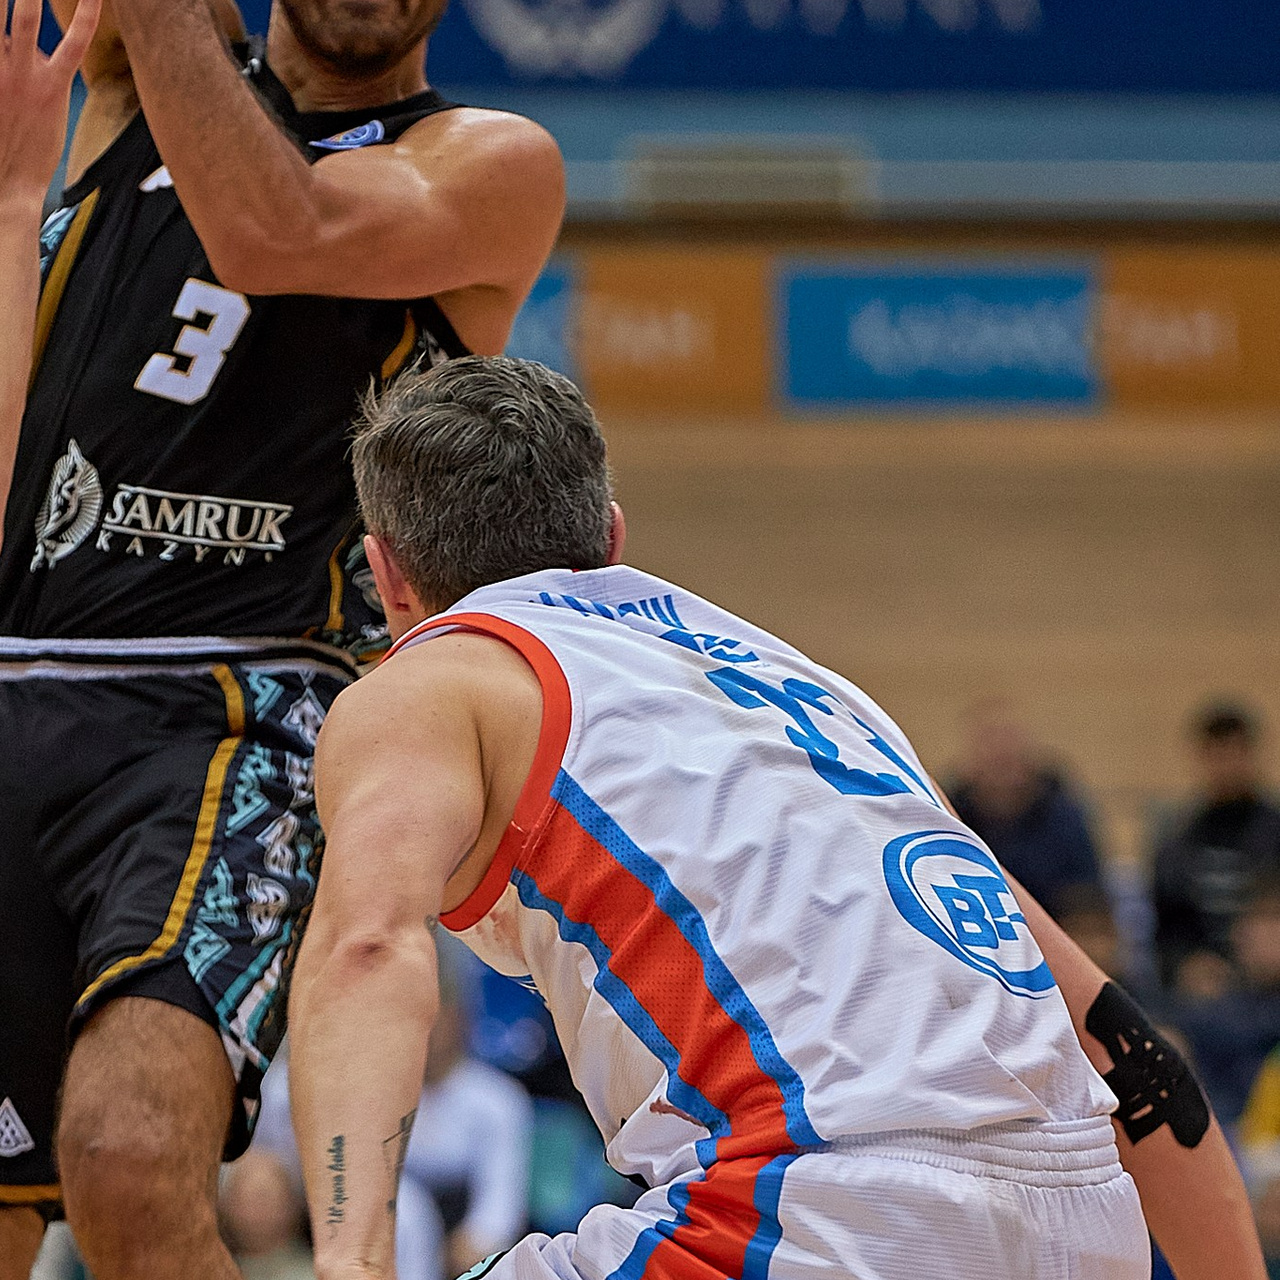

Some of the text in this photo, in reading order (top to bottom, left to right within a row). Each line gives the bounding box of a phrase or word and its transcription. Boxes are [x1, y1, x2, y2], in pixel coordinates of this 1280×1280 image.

[133, 277, 252, 406] 3
[104, 490, 293, 546] SAMRUK
[95, 530, 274, 566] KAZYN
